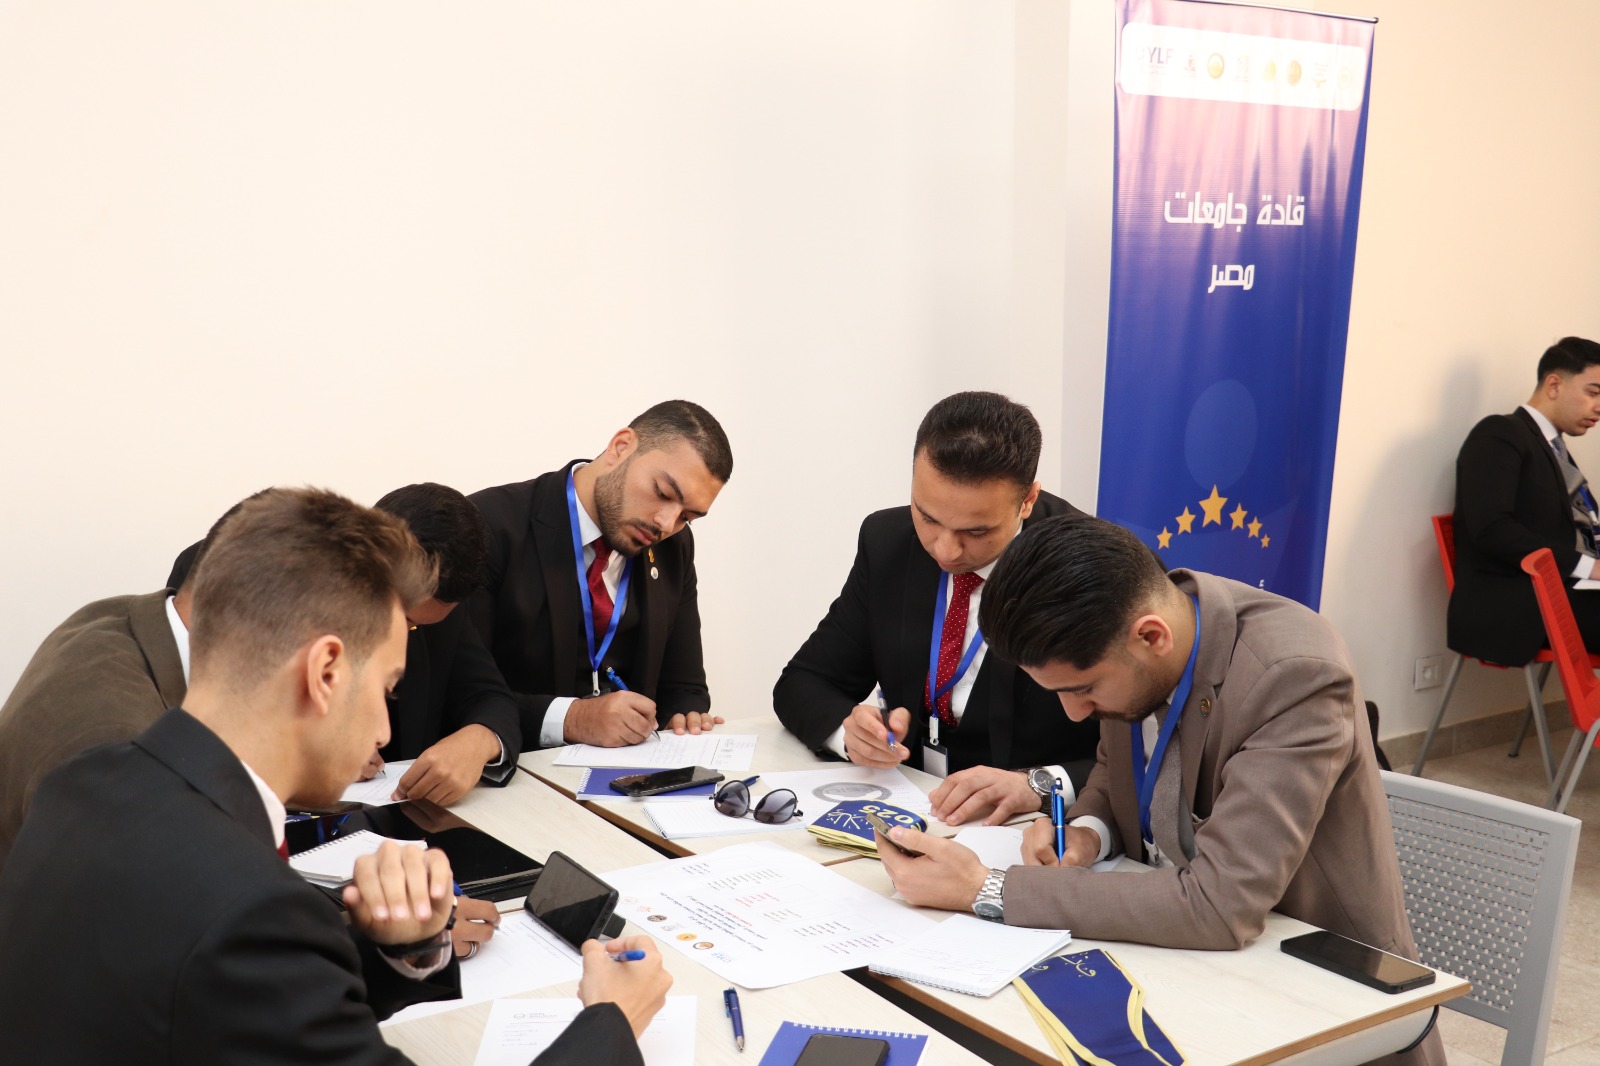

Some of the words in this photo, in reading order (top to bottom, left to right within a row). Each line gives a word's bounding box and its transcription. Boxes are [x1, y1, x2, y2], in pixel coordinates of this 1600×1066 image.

[1164, 191, 1248, 233] جامعات
[1256, 194, 1305, 226] قادة
[1207, 264, 1255, 294] مصر
